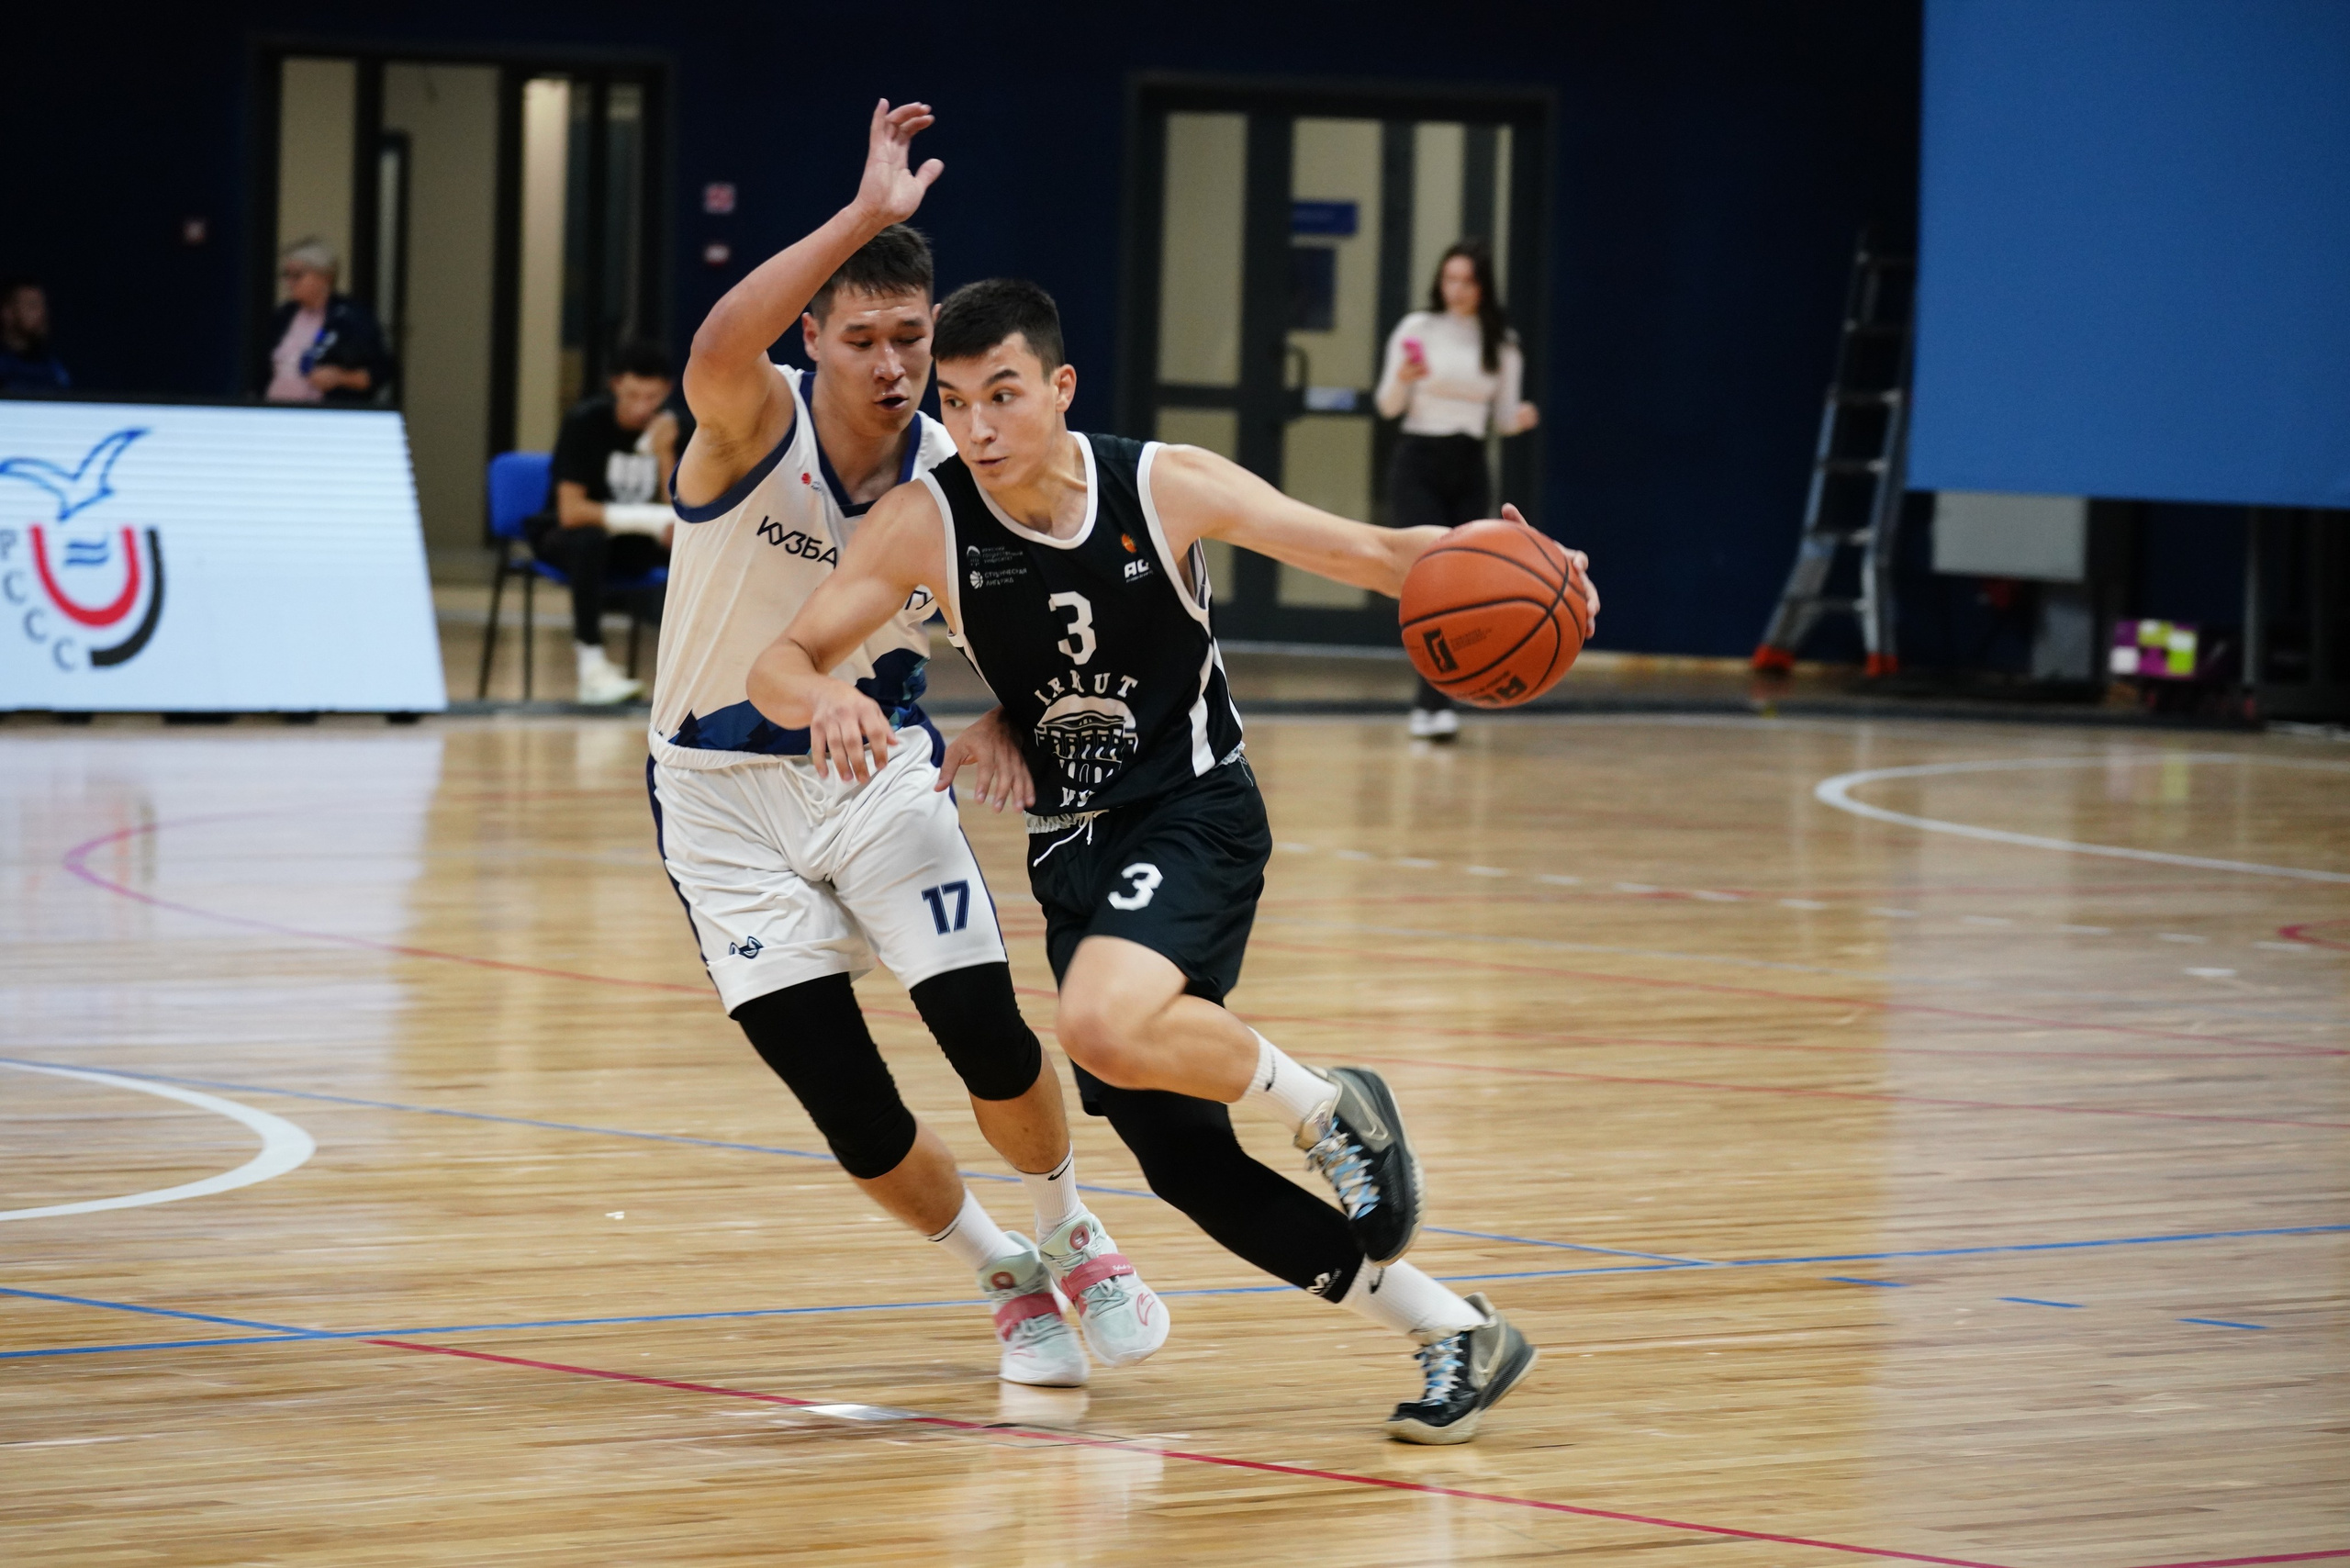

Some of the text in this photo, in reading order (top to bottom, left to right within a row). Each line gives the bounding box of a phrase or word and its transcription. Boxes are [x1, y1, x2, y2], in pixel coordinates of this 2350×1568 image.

[756, 515, 839, 569] КУЗБА
[1048, 590, 1097, 666] 3
[922, 879, 970, 935] 17
[1107, 862, 1163, 910] 3
